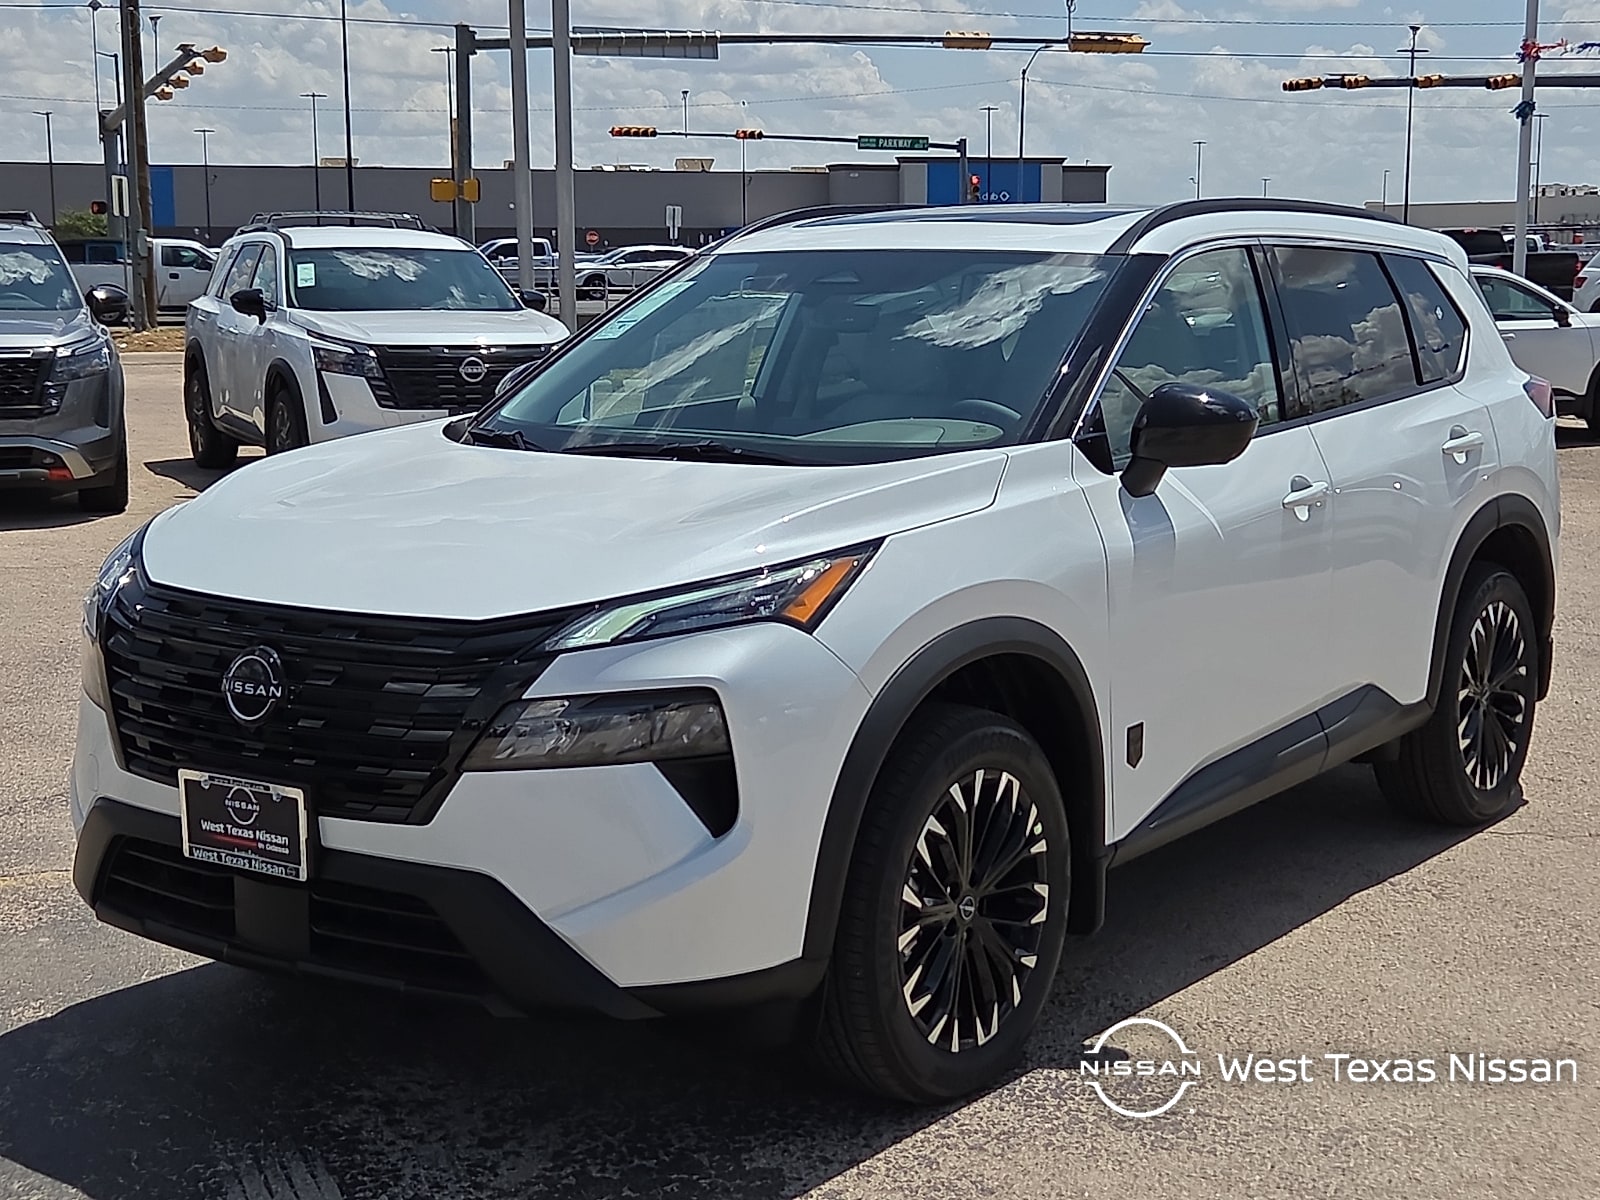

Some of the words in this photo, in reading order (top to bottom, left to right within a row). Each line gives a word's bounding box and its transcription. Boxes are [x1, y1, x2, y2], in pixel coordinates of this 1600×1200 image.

[878, 138, 912, 148] PARKWAY
[221, 679, 282, 697] NISSAN
[225, 799, 260, 812] NISSAN
[200, 819, 225, 834] West
[226, 824, 254, 839] Texas
[256, 830, 289, 846] Nissan
[192, 847, 218, 861] West
[220, 853, 249, 869] Texas
[251, 860, 286, 877] Nissan
